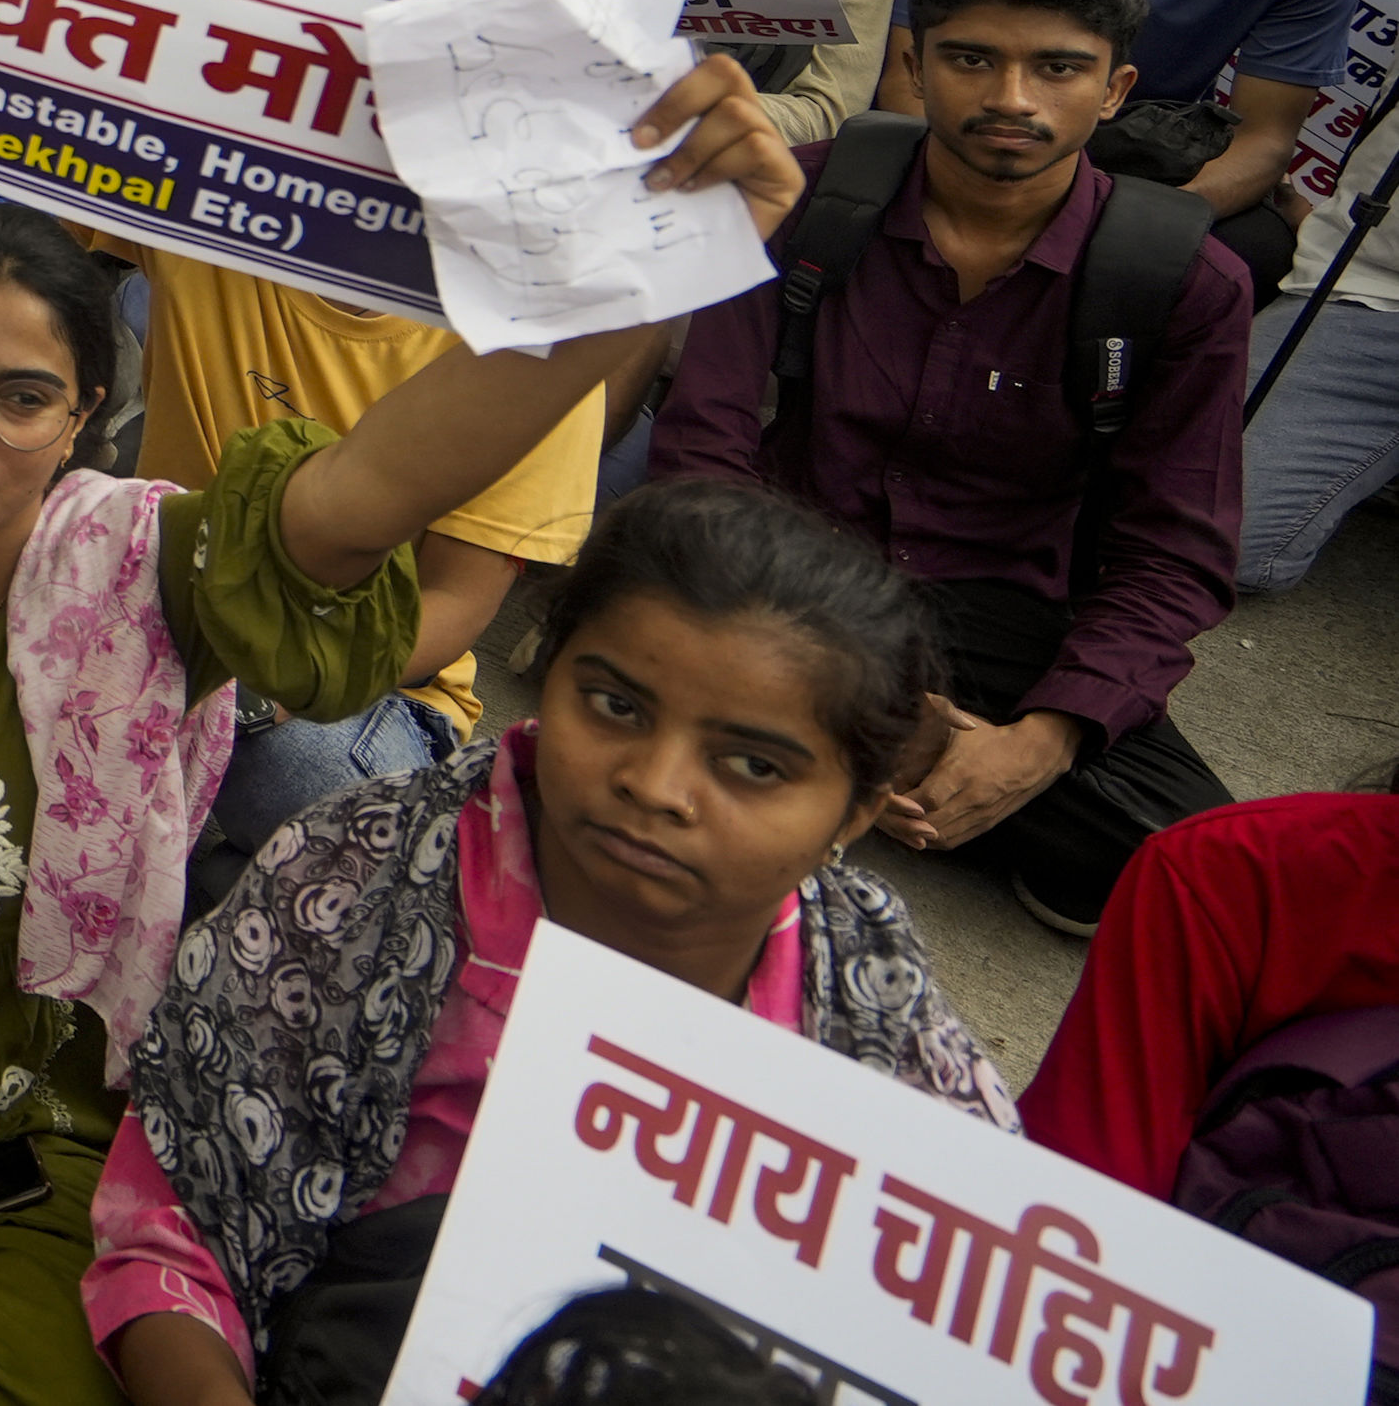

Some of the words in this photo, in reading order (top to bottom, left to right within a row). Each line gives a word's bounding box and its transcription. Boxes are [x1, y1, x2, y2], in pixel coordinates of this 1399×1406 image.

[190, 192, 307, 254] Etc)
[199, 145, 430, 242] Homegu
[574, 1035, 857, 1271] न्याय
